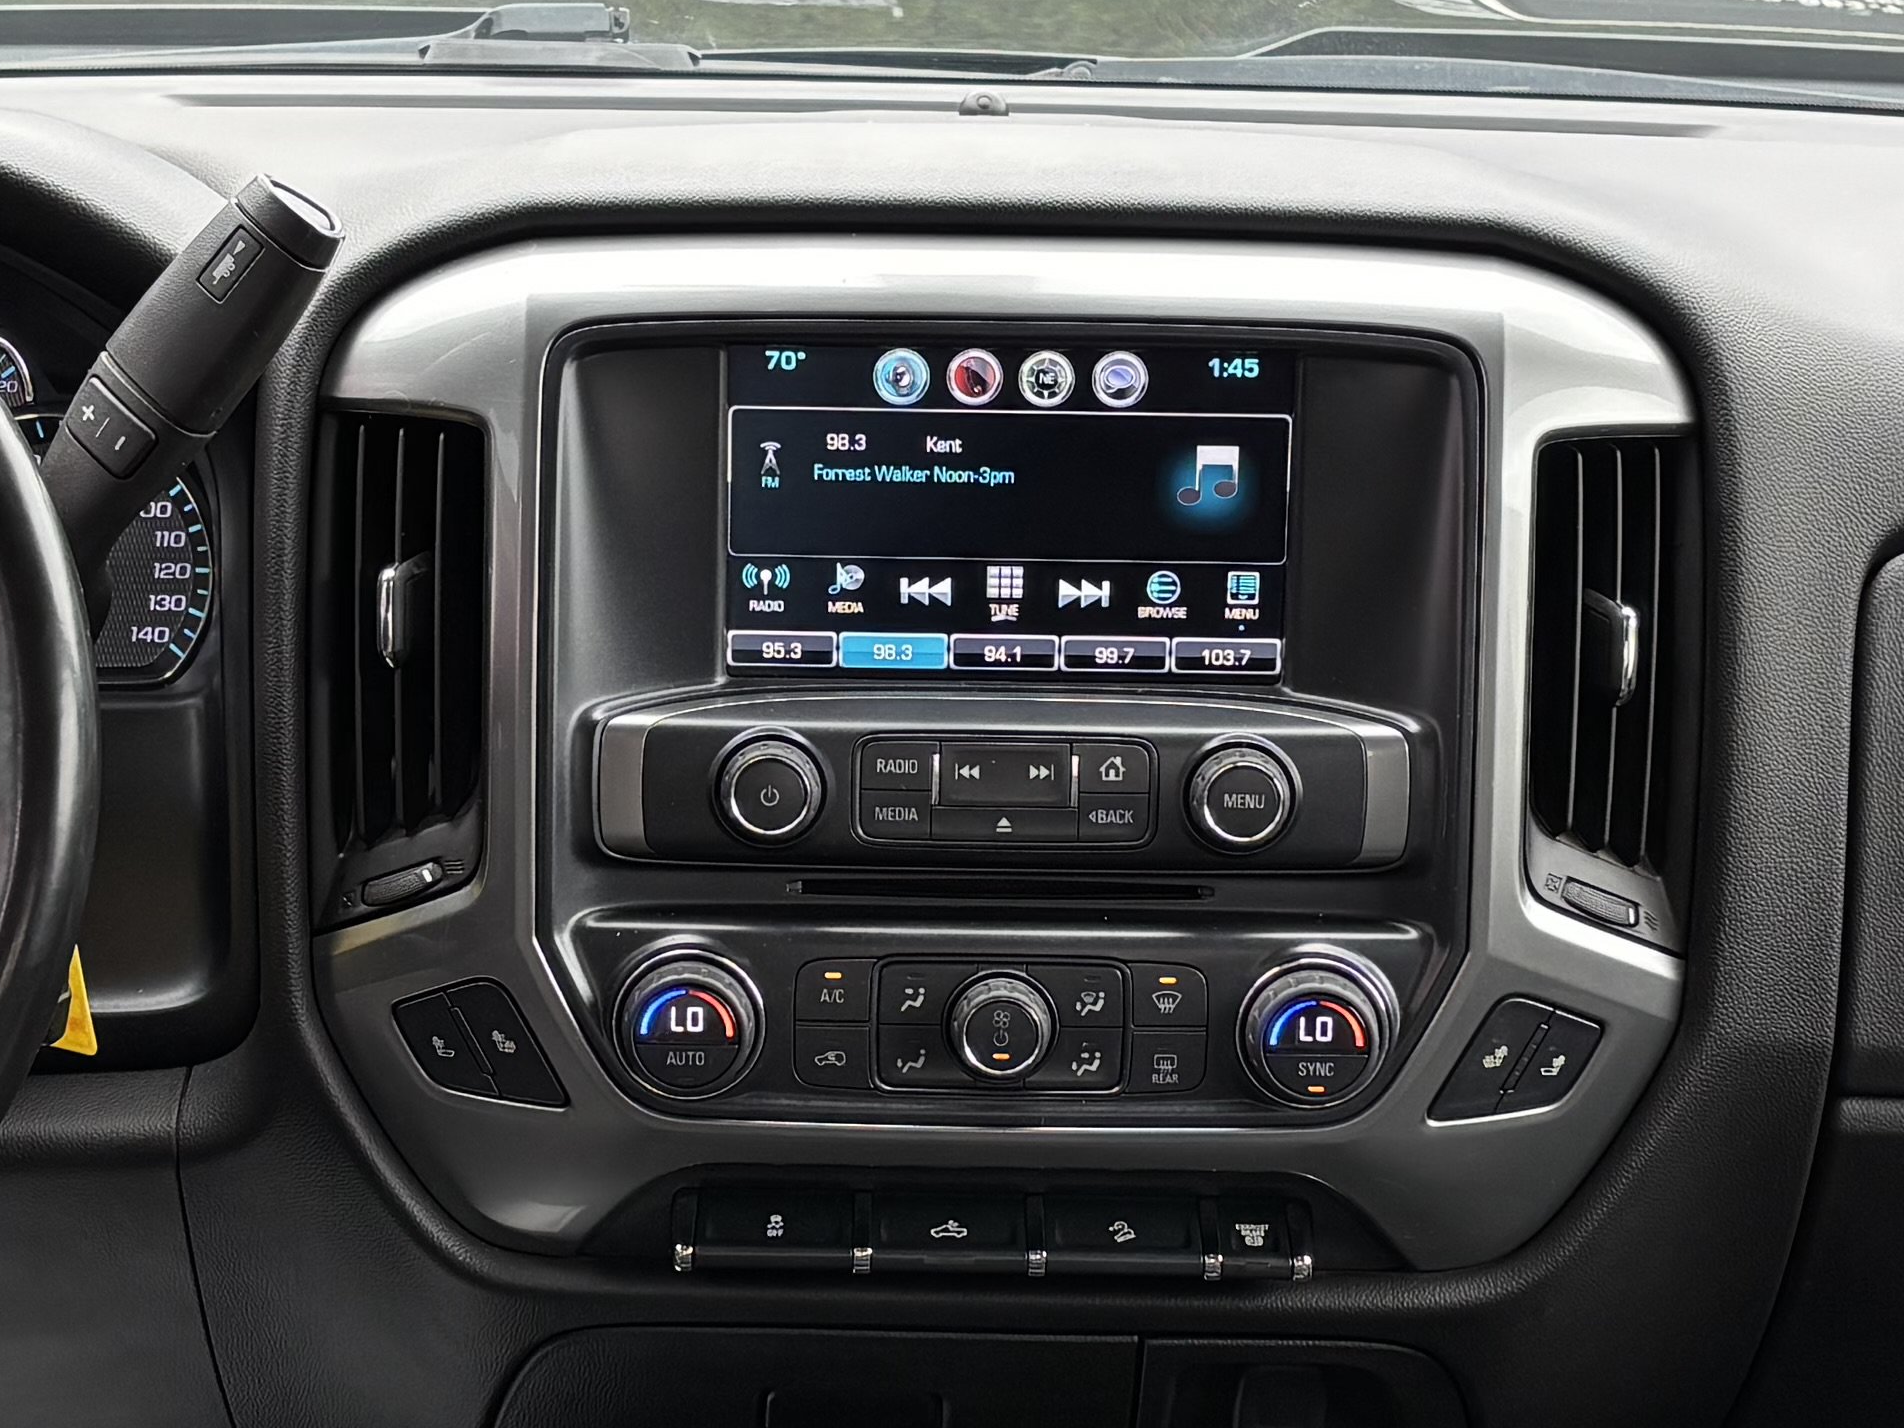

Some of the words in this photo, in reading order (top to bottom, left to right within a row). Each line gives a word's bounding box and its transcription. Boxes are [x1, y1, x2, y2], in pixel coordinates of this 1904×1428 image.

[765, 350, 807, 371] 70°
[1208, 357, 1261, 379] 1:45
[1039, 372, 1056, 385] NE
[826, 433, 867, 452] 98.3
[926, 435, 963, 455] Kent
[761, 476, 780, 489] FM
[814, 464, 871, 484] Forrest
[874, 465, 930, 485] Walker
[933, 465, 1015, 488] Noon-3pm
[139, 502, 171, 519] 00
[154, 531, 186, 548] 110
[153, 563, 191, 580] 120
[149, 595, 187, 612] 130
[748, 599, 786, 614] RADIO
[828, 601, 864, 614] MEDIA
[989, 604, 1019, 618] TUNE
[1138, 606, 1187, 620] BROWSE
[1225, 607, 1259, 621] MENU
[130, 626, 170, 644] 140
[761, 642, 803, 660] 95.3
[872, 643, 913, 662] 98.3
[983, 645, 1022, 663] 94.1
[1094, 646, 1135, 664] 99.7
[1201, 648, 1251, 667] 103.7
[876, 758, 918, 775] RADIO
[1223, 793, 1266, 811] MENU
[874, 806, 919, 822] MEDIA
[1098, 809, 1134, 826] BACK
[821, 987, 844, 1004] A/C
[670, 1008, 703, 1033] LO
[1300, 1019, 1332, 1043] LO
[666, 1050, 705, 1066] AUTO
[1298, 1061, 1335, 1077] SYNC
[1152, 1072, 1178, 1084] REAR
